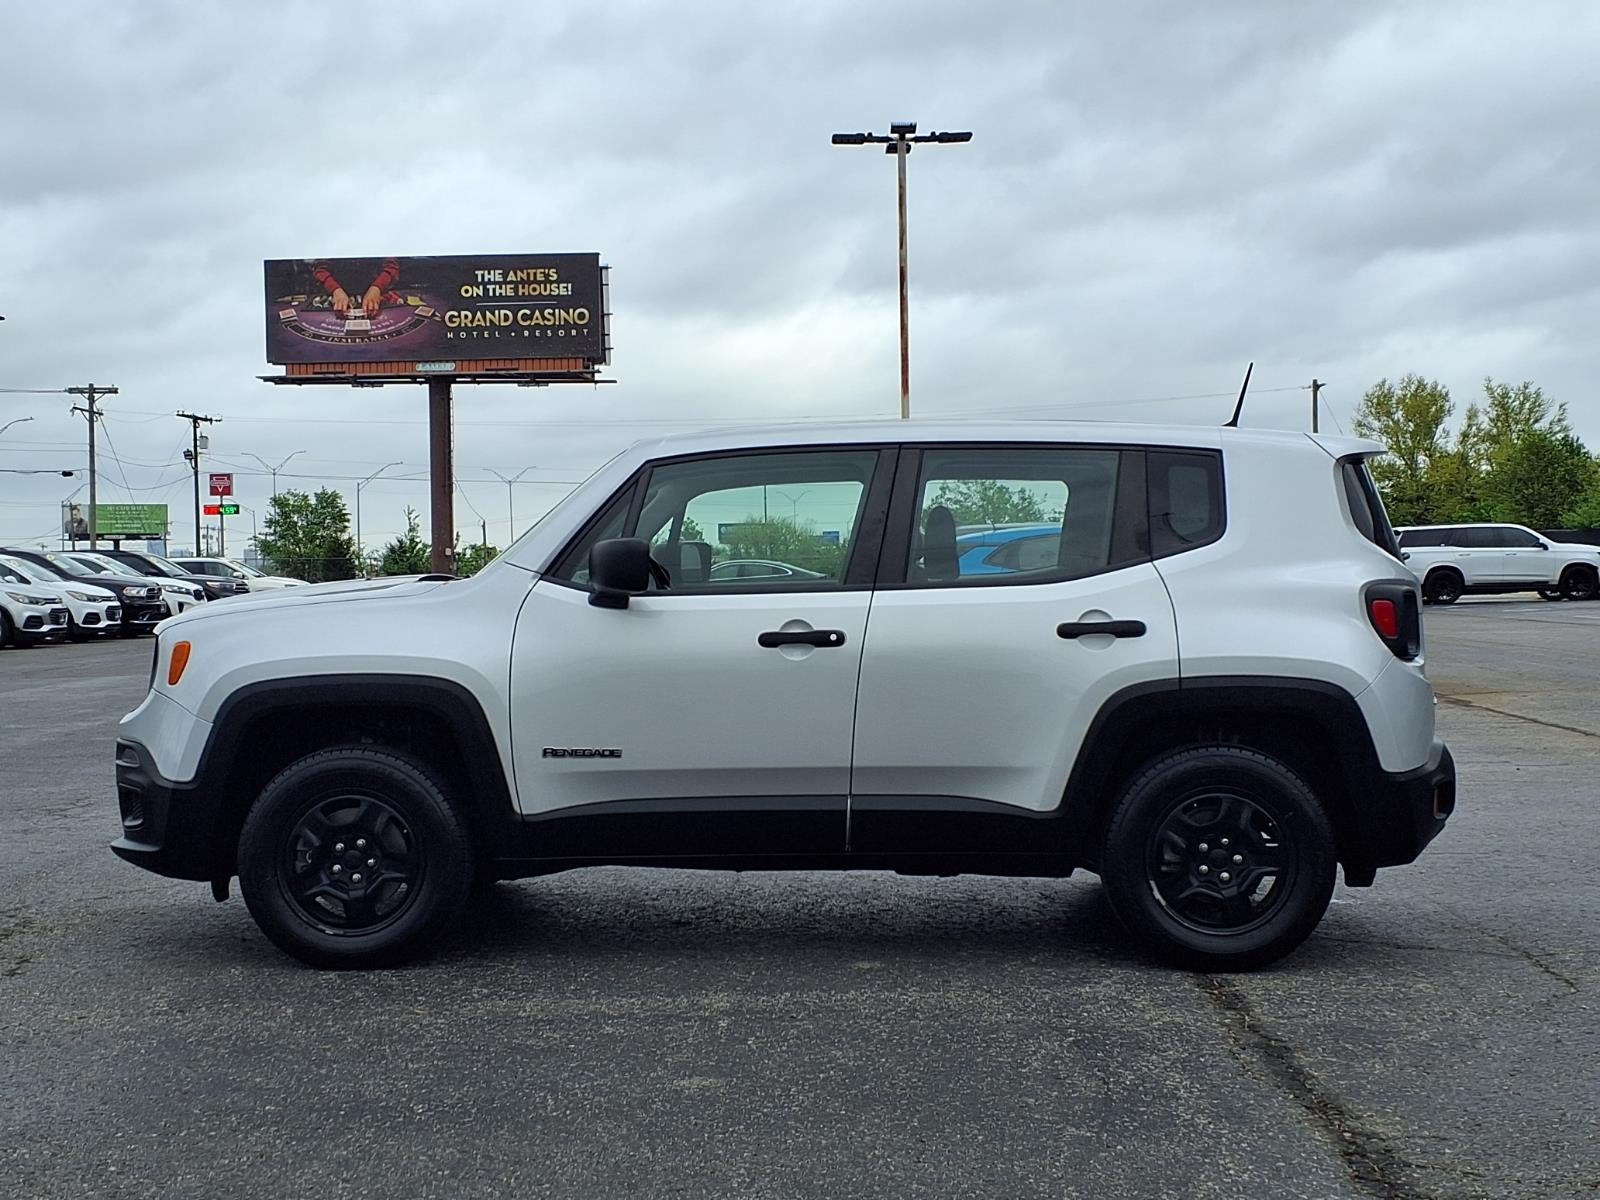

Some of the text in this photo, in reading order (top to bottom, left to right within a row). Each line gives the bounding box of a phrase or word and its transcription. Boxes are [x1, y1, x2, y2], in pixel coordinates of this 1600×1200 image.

[475, 268, 558, 282] THE ANTE'S
[460, 283, 572, 297] ON THE HOUSE!
[444, 307, 590, 327] GRAND CASINO
[447, 328, 589, 339] HOTEL RESORT
